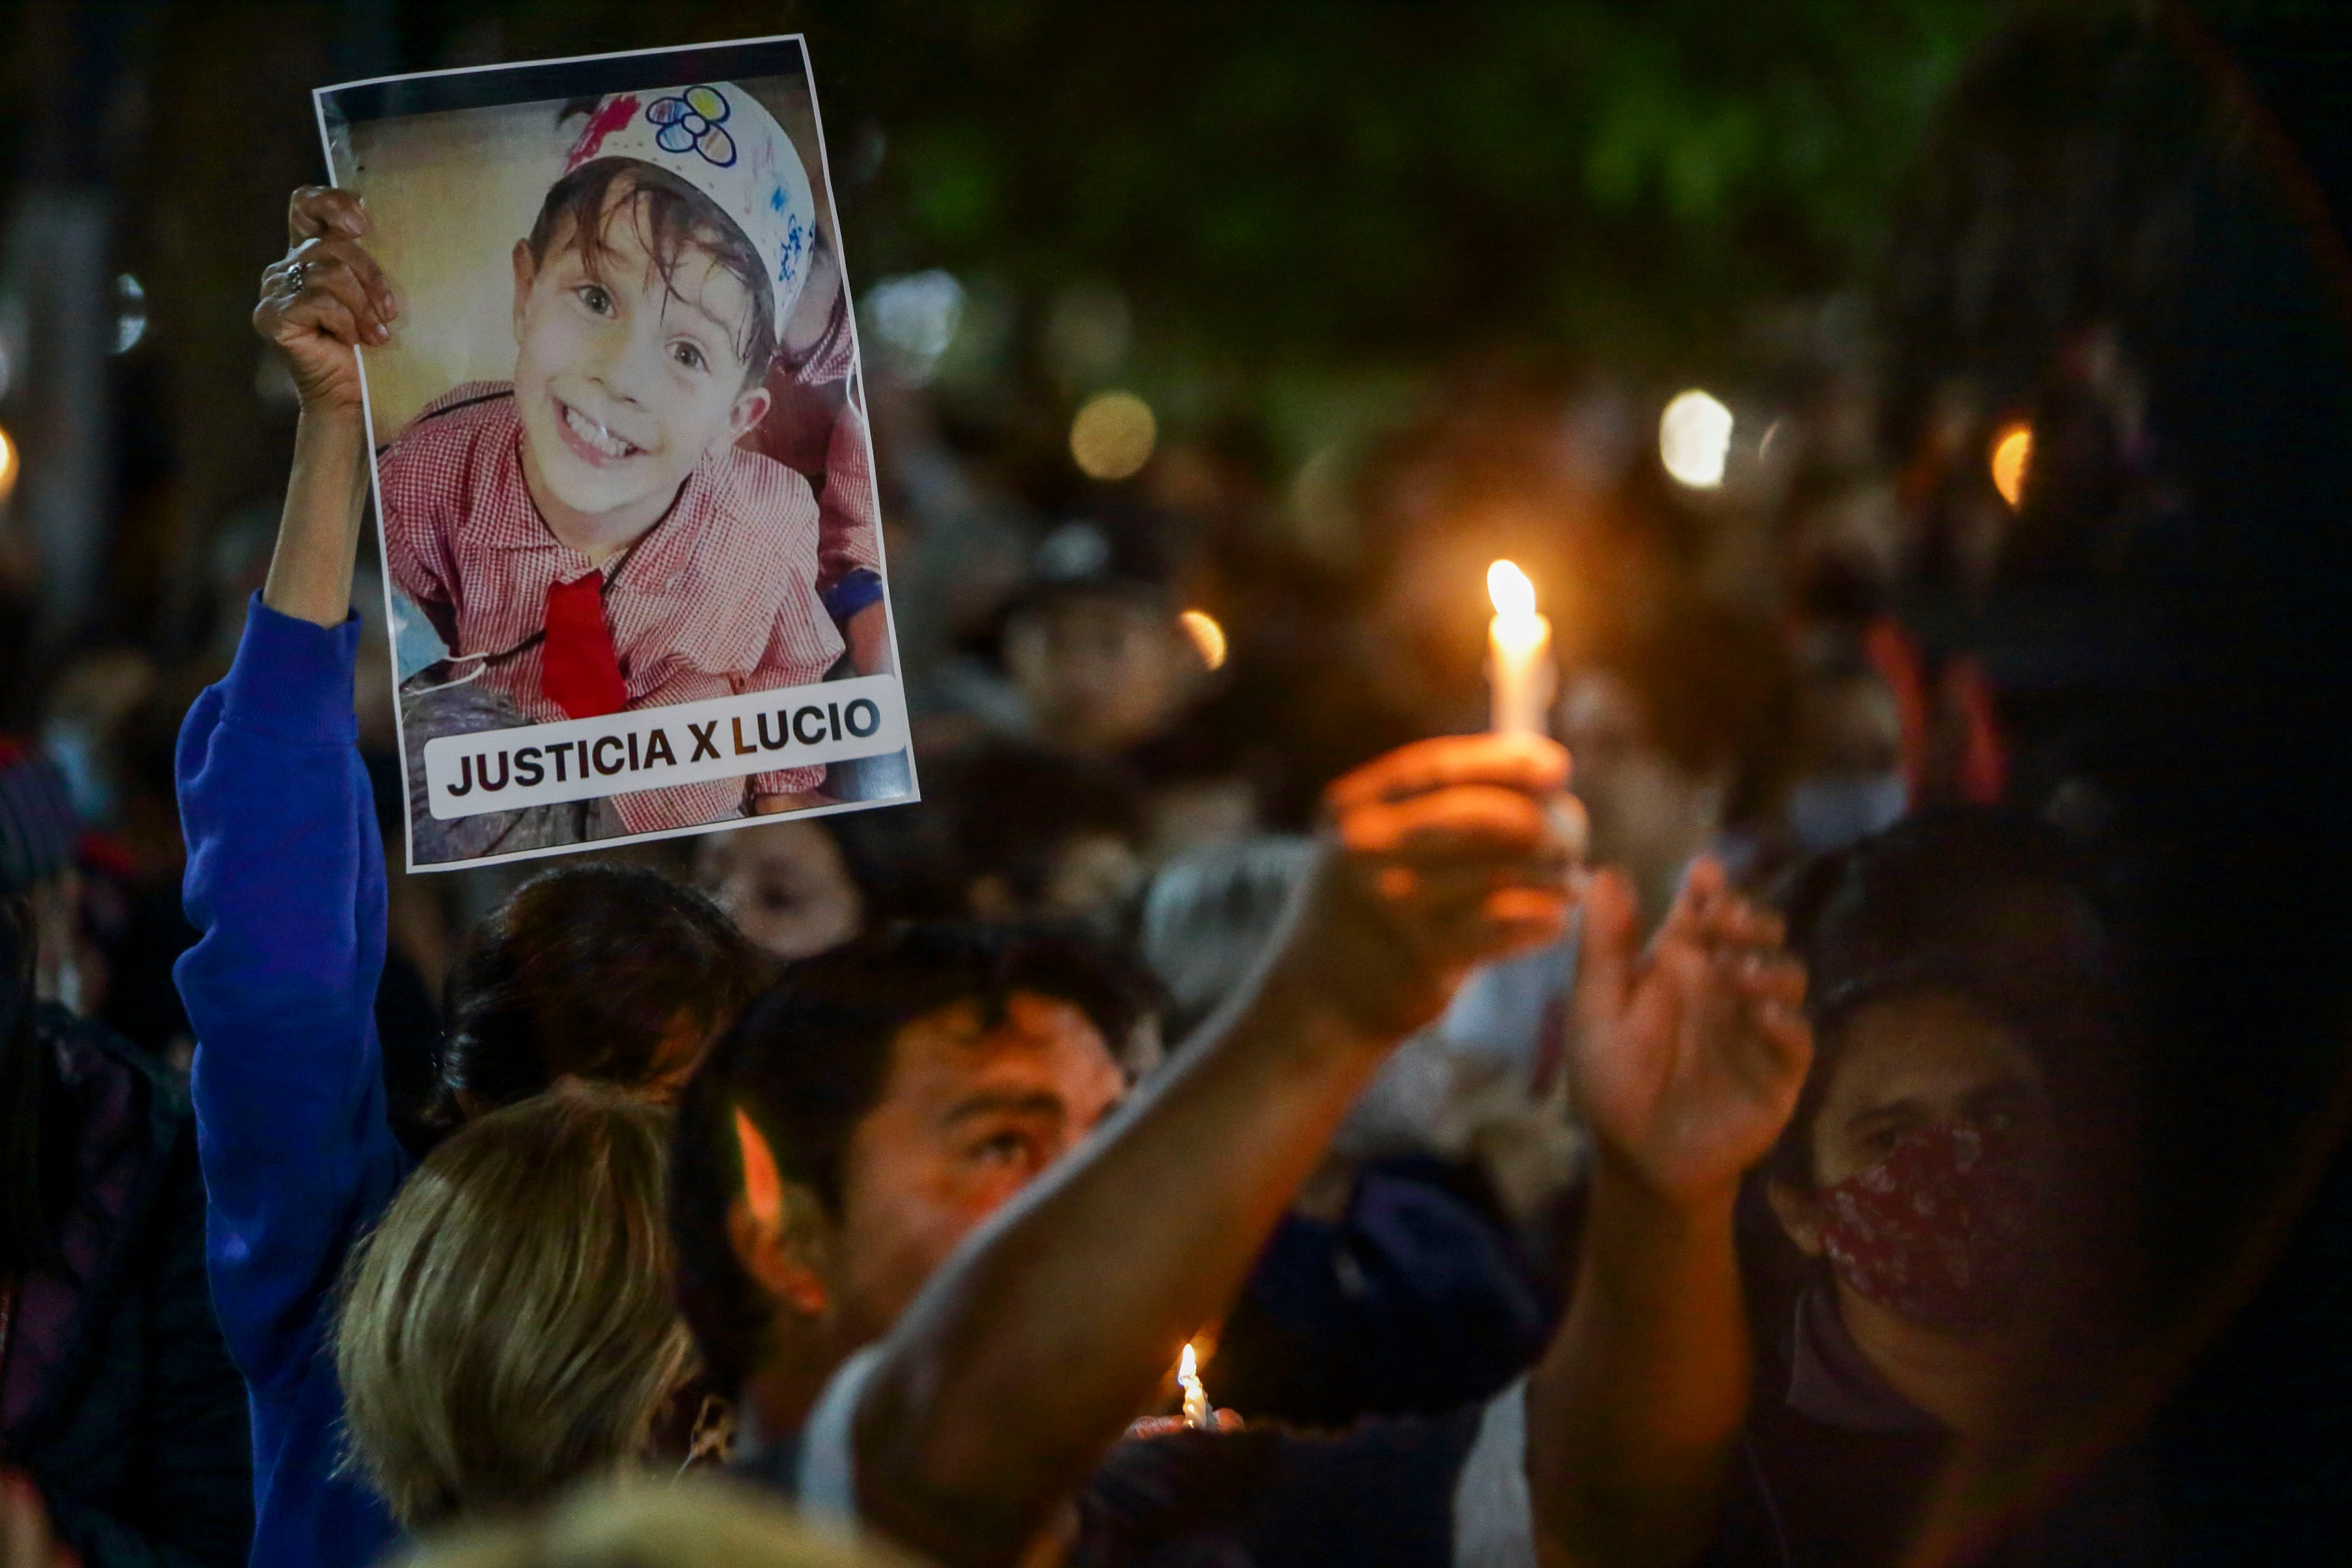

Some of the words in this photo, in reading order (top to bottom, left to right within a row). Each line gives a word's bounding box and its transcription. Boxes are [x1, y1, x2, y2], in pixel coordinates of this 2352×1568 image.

[446, 727, 677, 797] JUSTICIA
[687, 720, 722, 763] X
[731, 698, 881, 756] LUCIO
